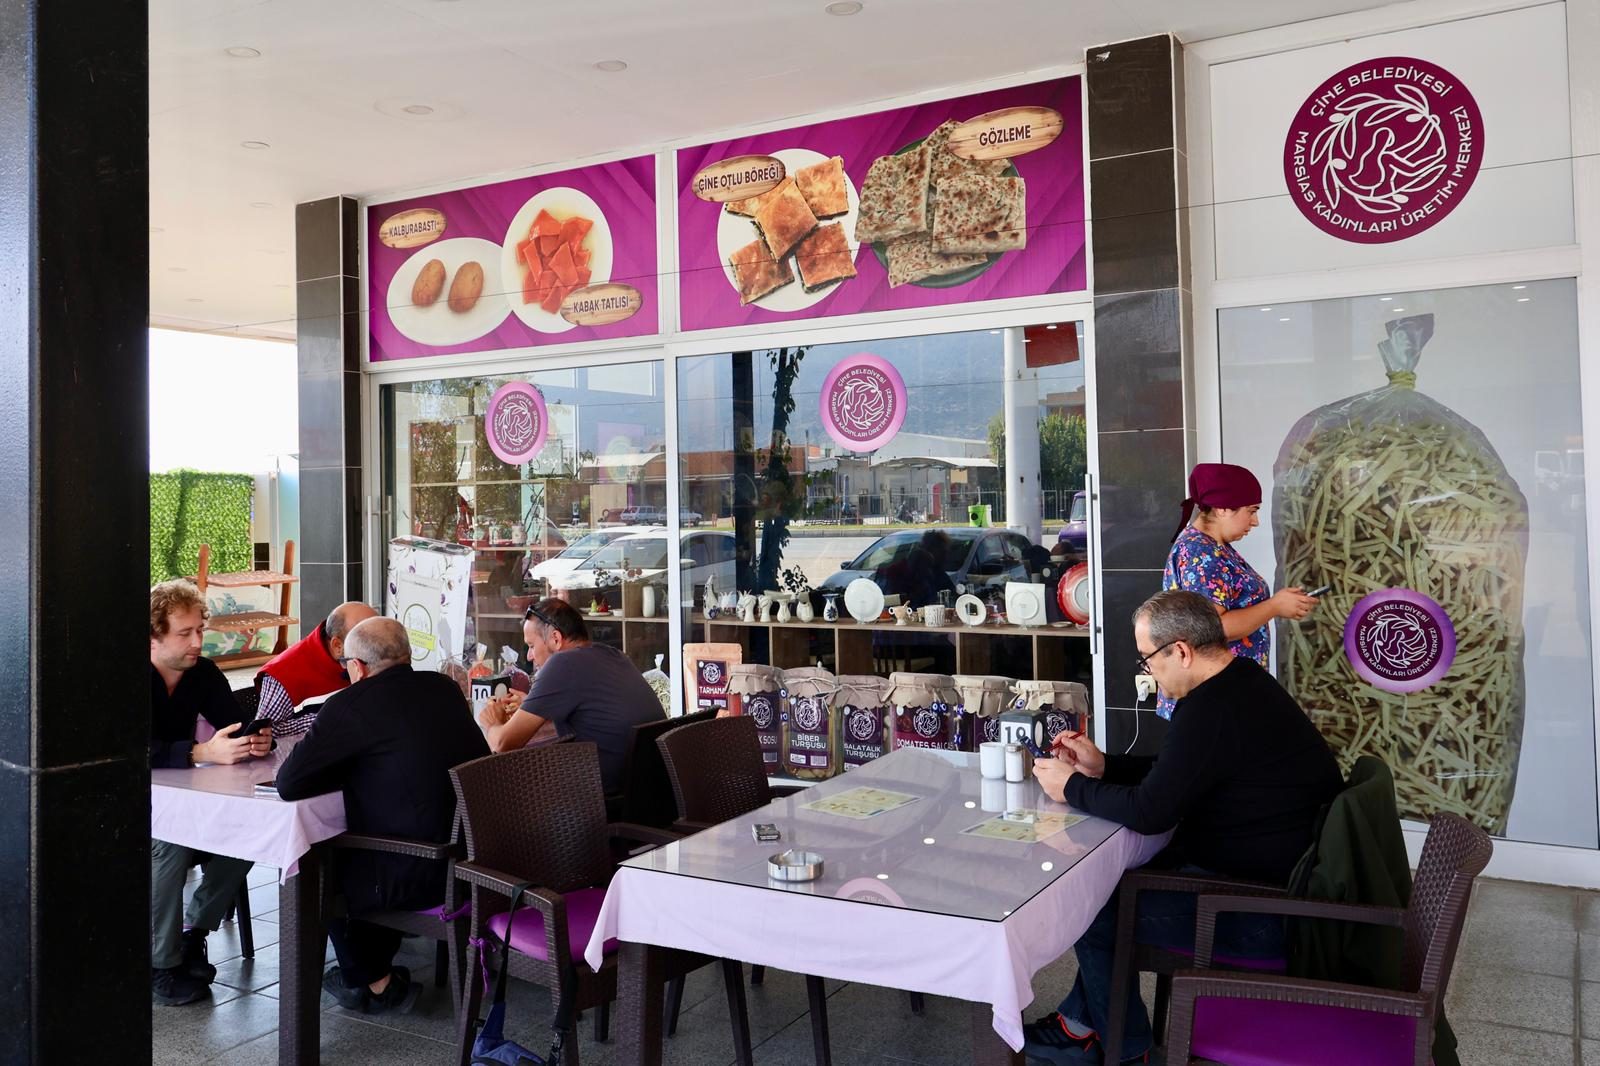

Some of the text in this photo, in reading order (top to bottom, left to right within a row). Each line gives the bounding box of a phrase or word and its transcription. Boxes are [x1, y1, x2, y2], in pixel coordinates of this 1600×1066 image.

[1310, 66, 1453, 117] ÇİNE BELEDİYESİ
[979, 124, 1032, 146] GÖZLEME
[698, 162, 780, 192] ÇİNE OTLU BÖREĞİ
[1294, 106, 1472, 233] MARSİAS KADINLARI ÜRETİM MERKEZİ
[389, 220, 437, 238] KALBURABASTI
[573, 296, 629, 313] KABAK TATLISI
[851, 368, 888, 385] BELEDİYESİ
[1367, 604, 1430, 622] ÇİNE BELEDİYESİ
[1360, 625, 1438, 677] MARSİAS KADINLARI ÜRETİM MERKEZİ
[474, 688, 488, 700] 10
[792, 740, 826, 750] TURŞUSU
[797, 733, 820, 742] BİBER
[896, 738, 930, 748] DOMATES
[844, 743, 881, 753] SALATALIK
[846, 750, 880, 759] TURŞUSU
